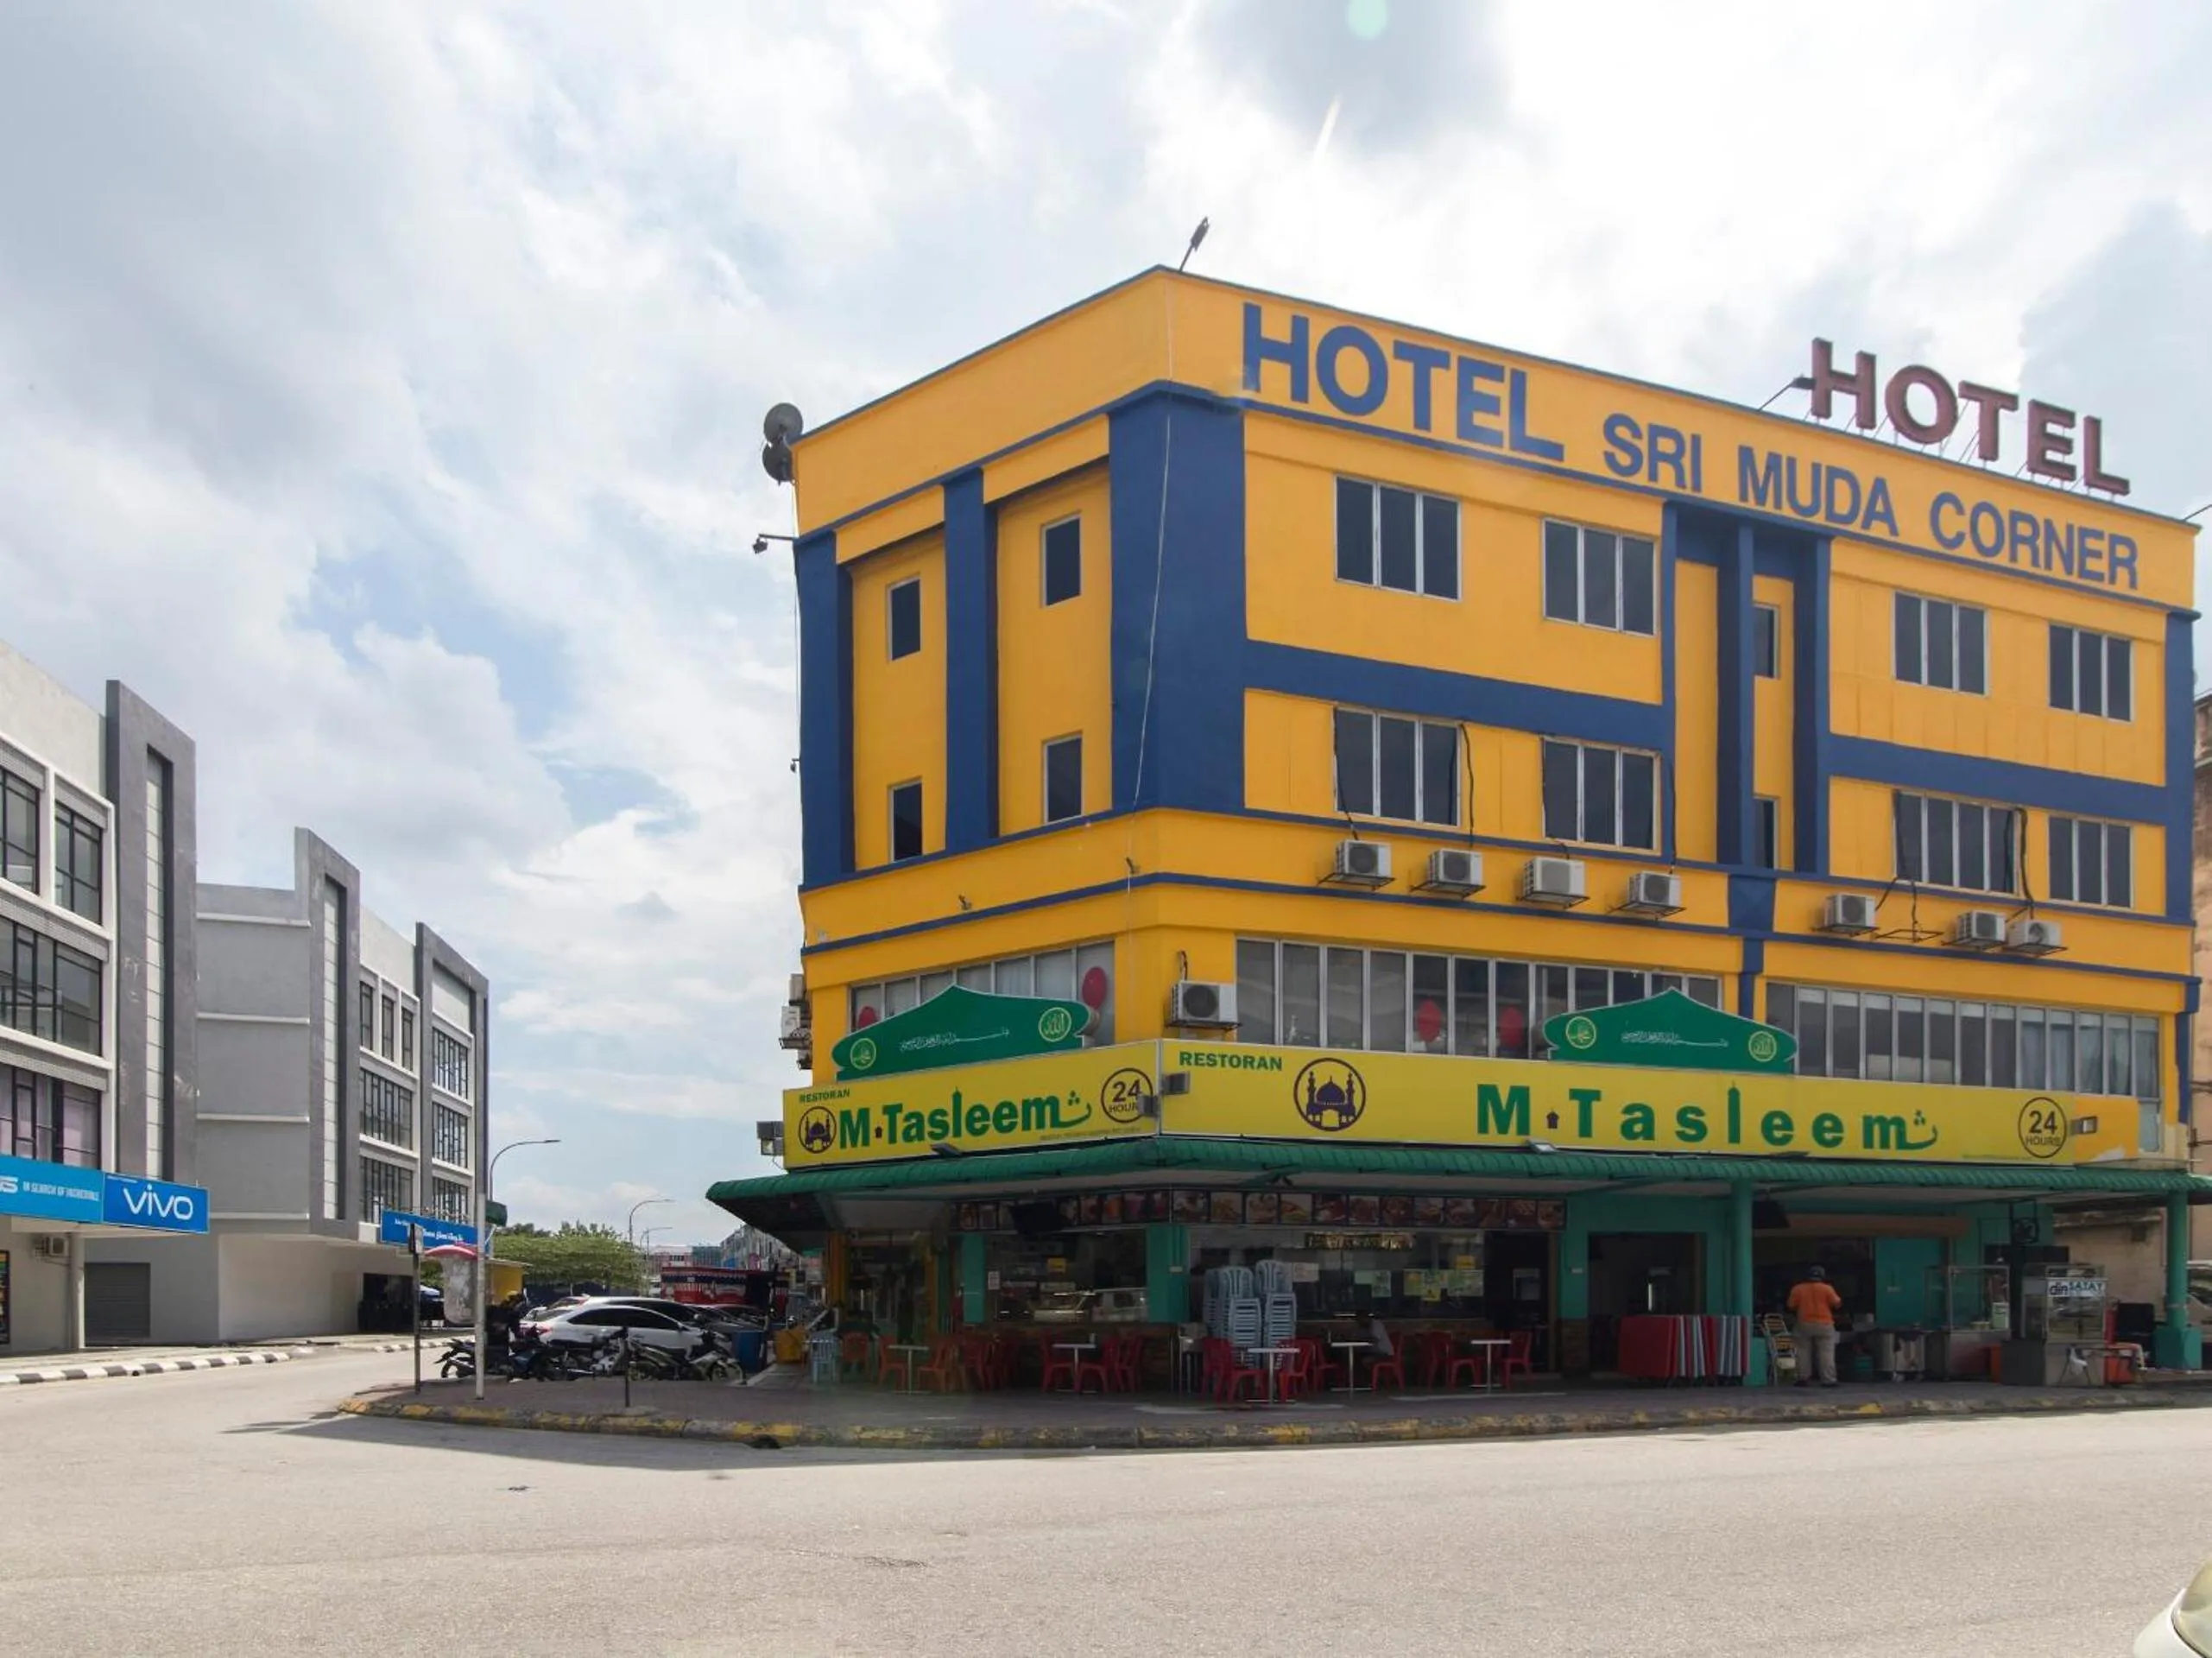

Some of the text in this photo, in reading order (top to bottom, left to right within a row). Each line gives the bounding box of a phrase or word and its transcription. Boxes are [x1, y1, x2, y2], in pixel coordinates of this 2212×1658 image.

[1811, 337, 2130, 496] HOTEL
[1242, 301, 2139, 590] HOTEL SRI MUDA CORNER
[1179, 1051, 1282, 1071] RESTORAN
[799, 1088, 850, 1103] RESTORAN
[1113, 1079, 1141, 1103] 24
[1109, 1102, 1139, 1113] HOUR
[2029, 1111, 2058, 1135] 24
[2026, 1136, 2061, 1147] HOURS
